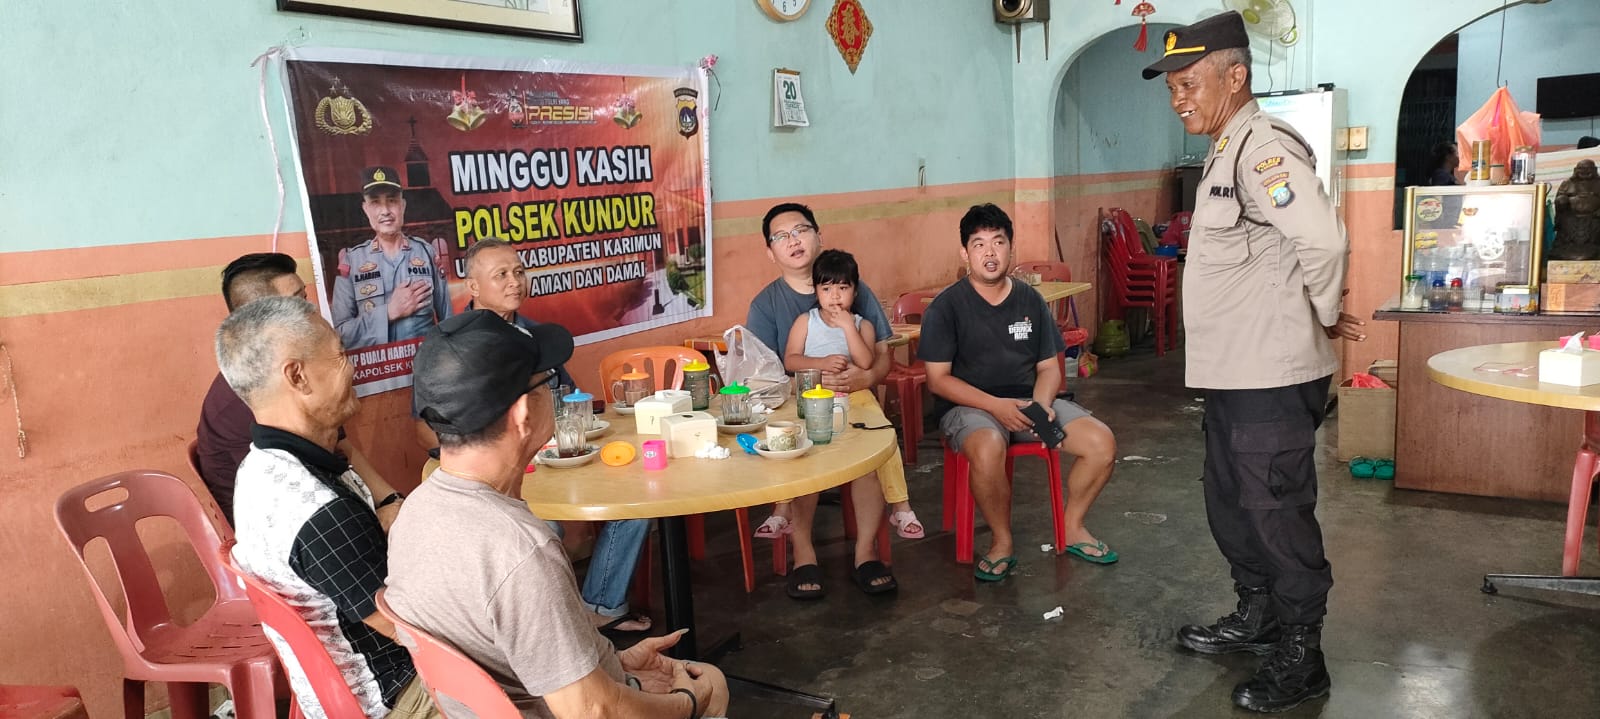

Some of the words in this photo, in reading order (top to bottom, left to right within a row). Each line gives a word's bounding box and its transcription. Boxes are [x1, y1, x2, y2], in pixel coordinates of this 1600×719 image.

[782, 1, 787, 13] 6
[783, 80, 797, 100] 20
[528, 106, 594, 121] PRESISI
[450, 150, 570, 193] MINGGU
[576, 147, 652, 184] KASIH
[1209, 186, 1234, 198] POLRI
[455, 202, 560, 248] POLSEK
[563, 194, 656, 236] KUNDUR
[517, 245, 600, 269] KABUPATEN
[603, 233, 662, 256] KARIMUN
[407, 267, 430, 276] POLRI
[530, 271, 572, 297] AMAN
[575, 267, 603, 290] DAN
[606, 261, 646, 284] DAMAI
[348, 354, 359, 368] KP
[360, 348, 387, 366] BUALA
[353, 362, 404, 380] KAPOLSEK
